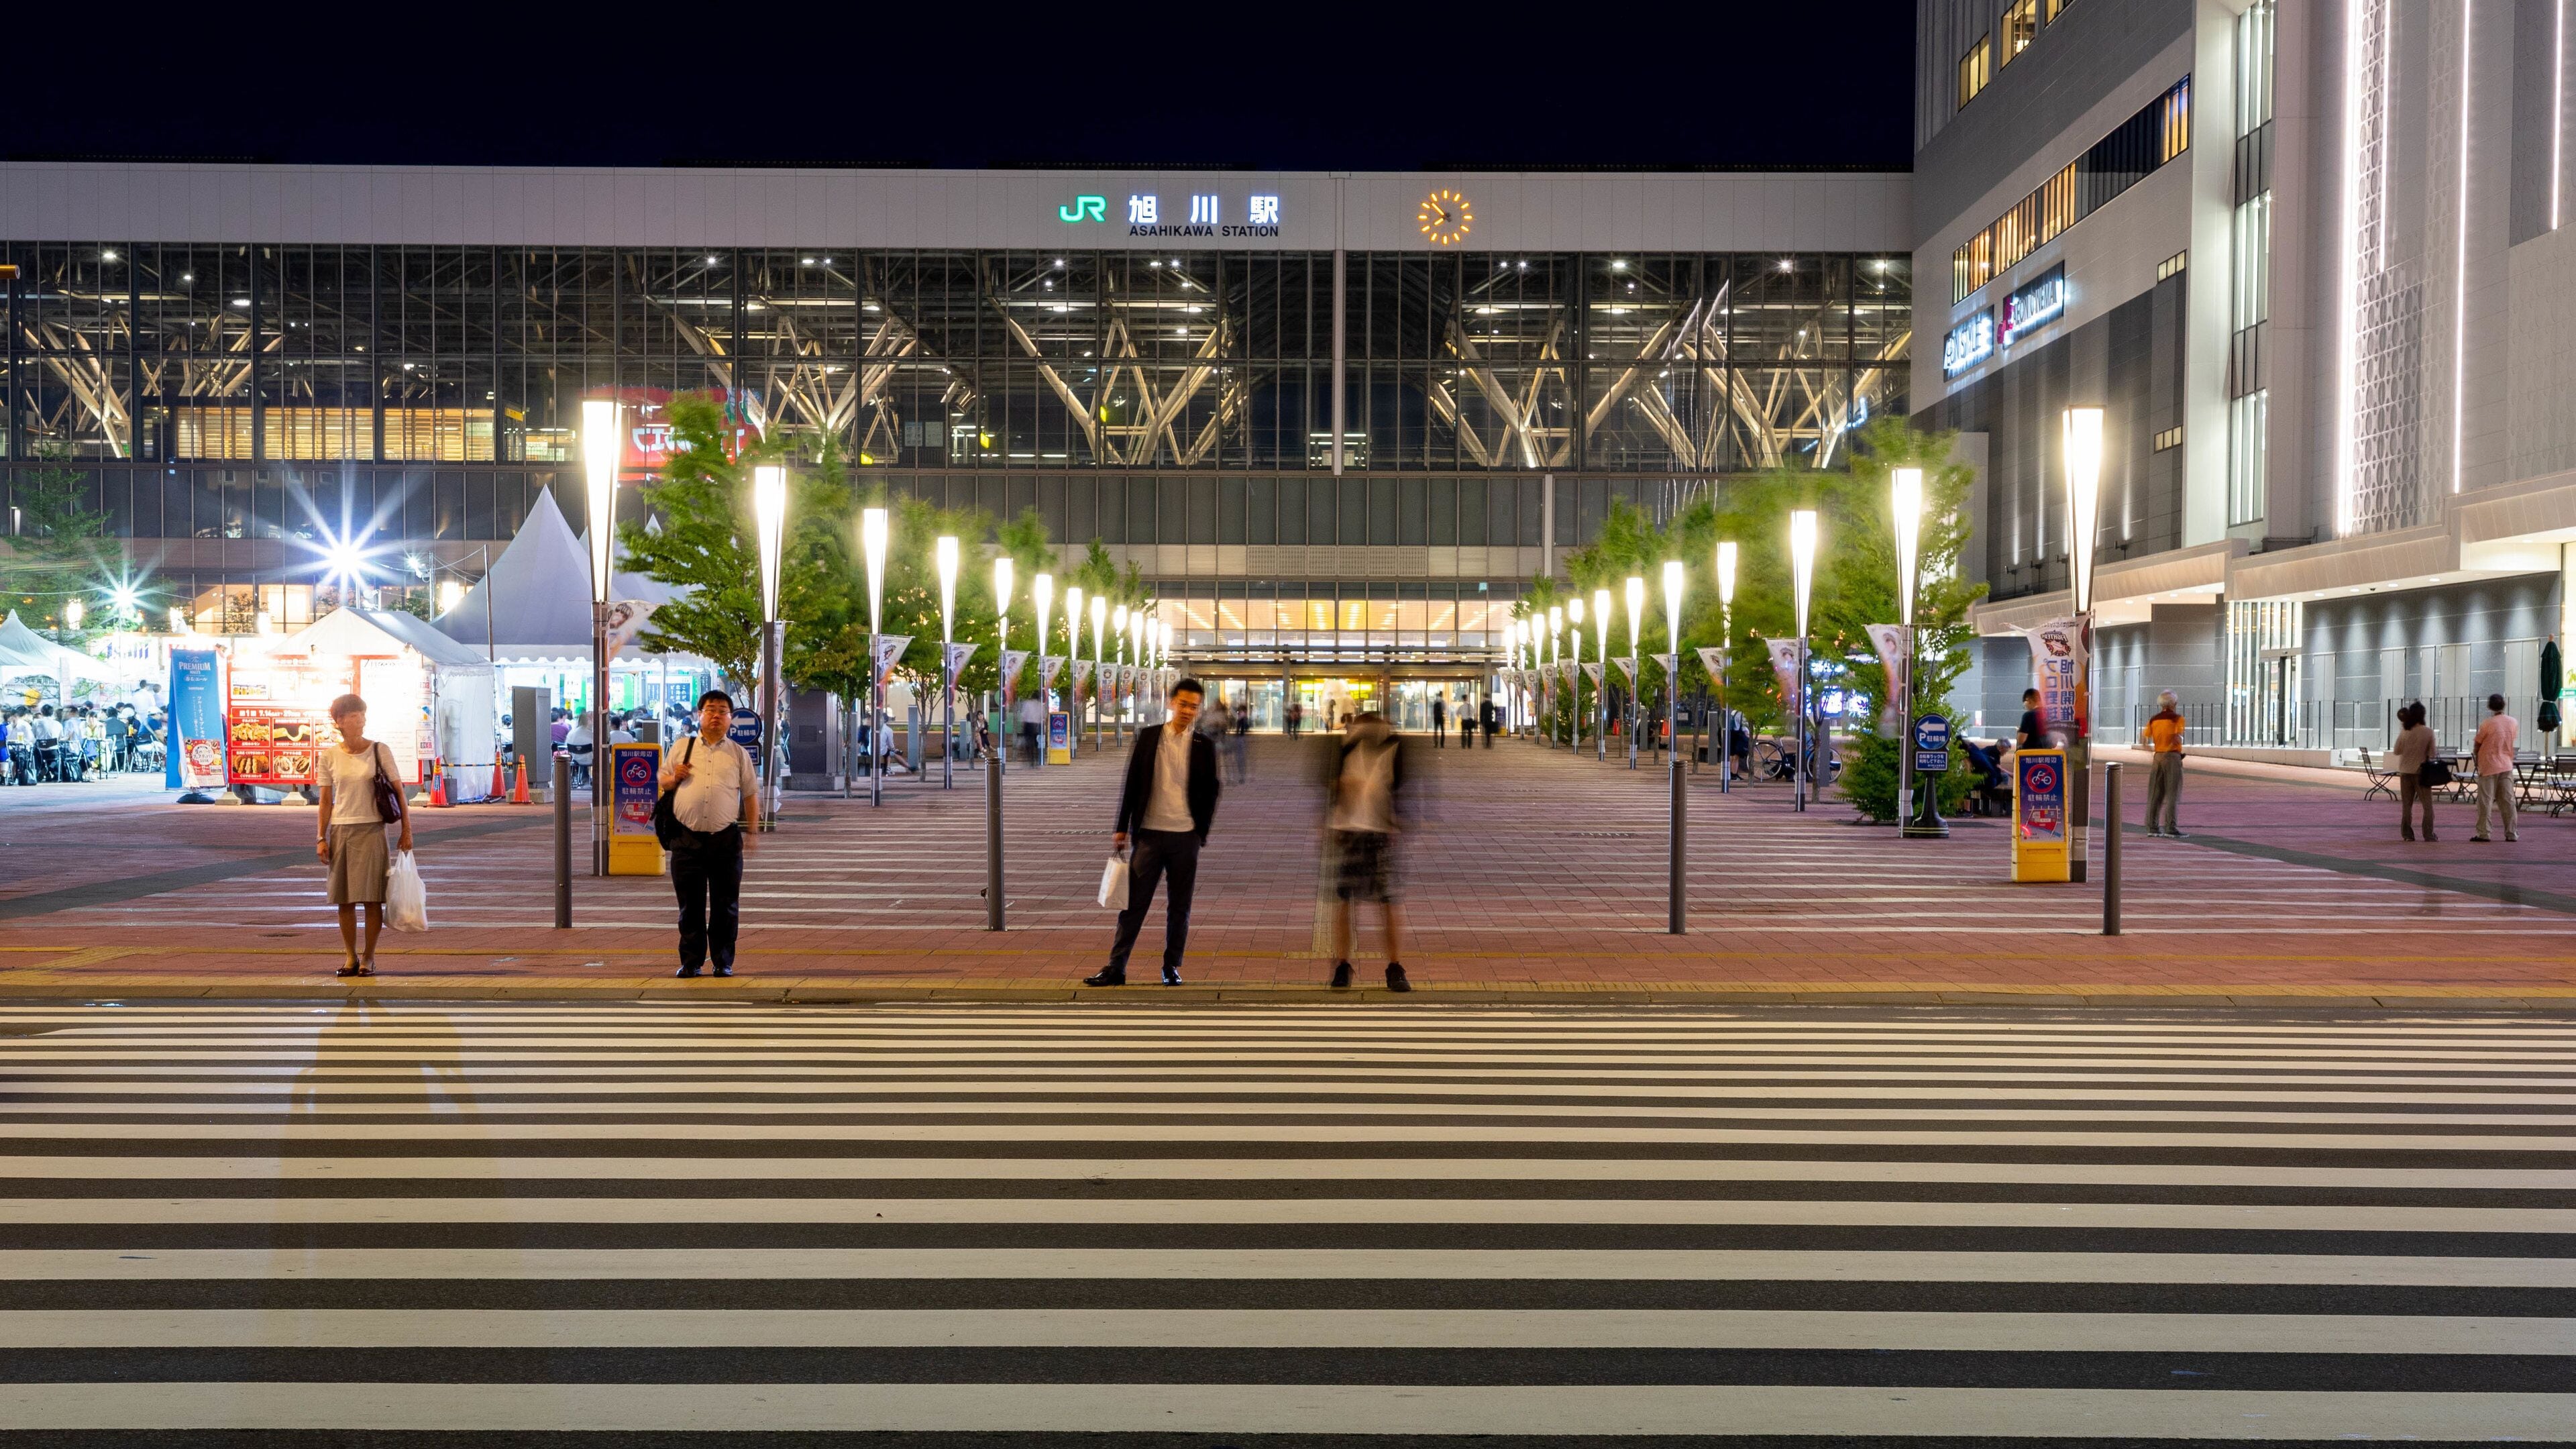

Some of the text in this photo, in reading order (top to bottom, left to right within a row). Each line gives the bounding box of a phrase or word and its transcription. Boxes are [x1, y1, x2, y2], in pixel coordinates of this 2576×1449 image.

[1059, 195, 1107, 223] JR
[1129, 195, 1279, 224] 旭川駅
[1129, 225, 1279, 237] ASAHIKAWA STATION
[178, 661, 211, 671] PREMIUM
[730, 727, 737, 737] P
[1919, 733, 1926, 742] P
